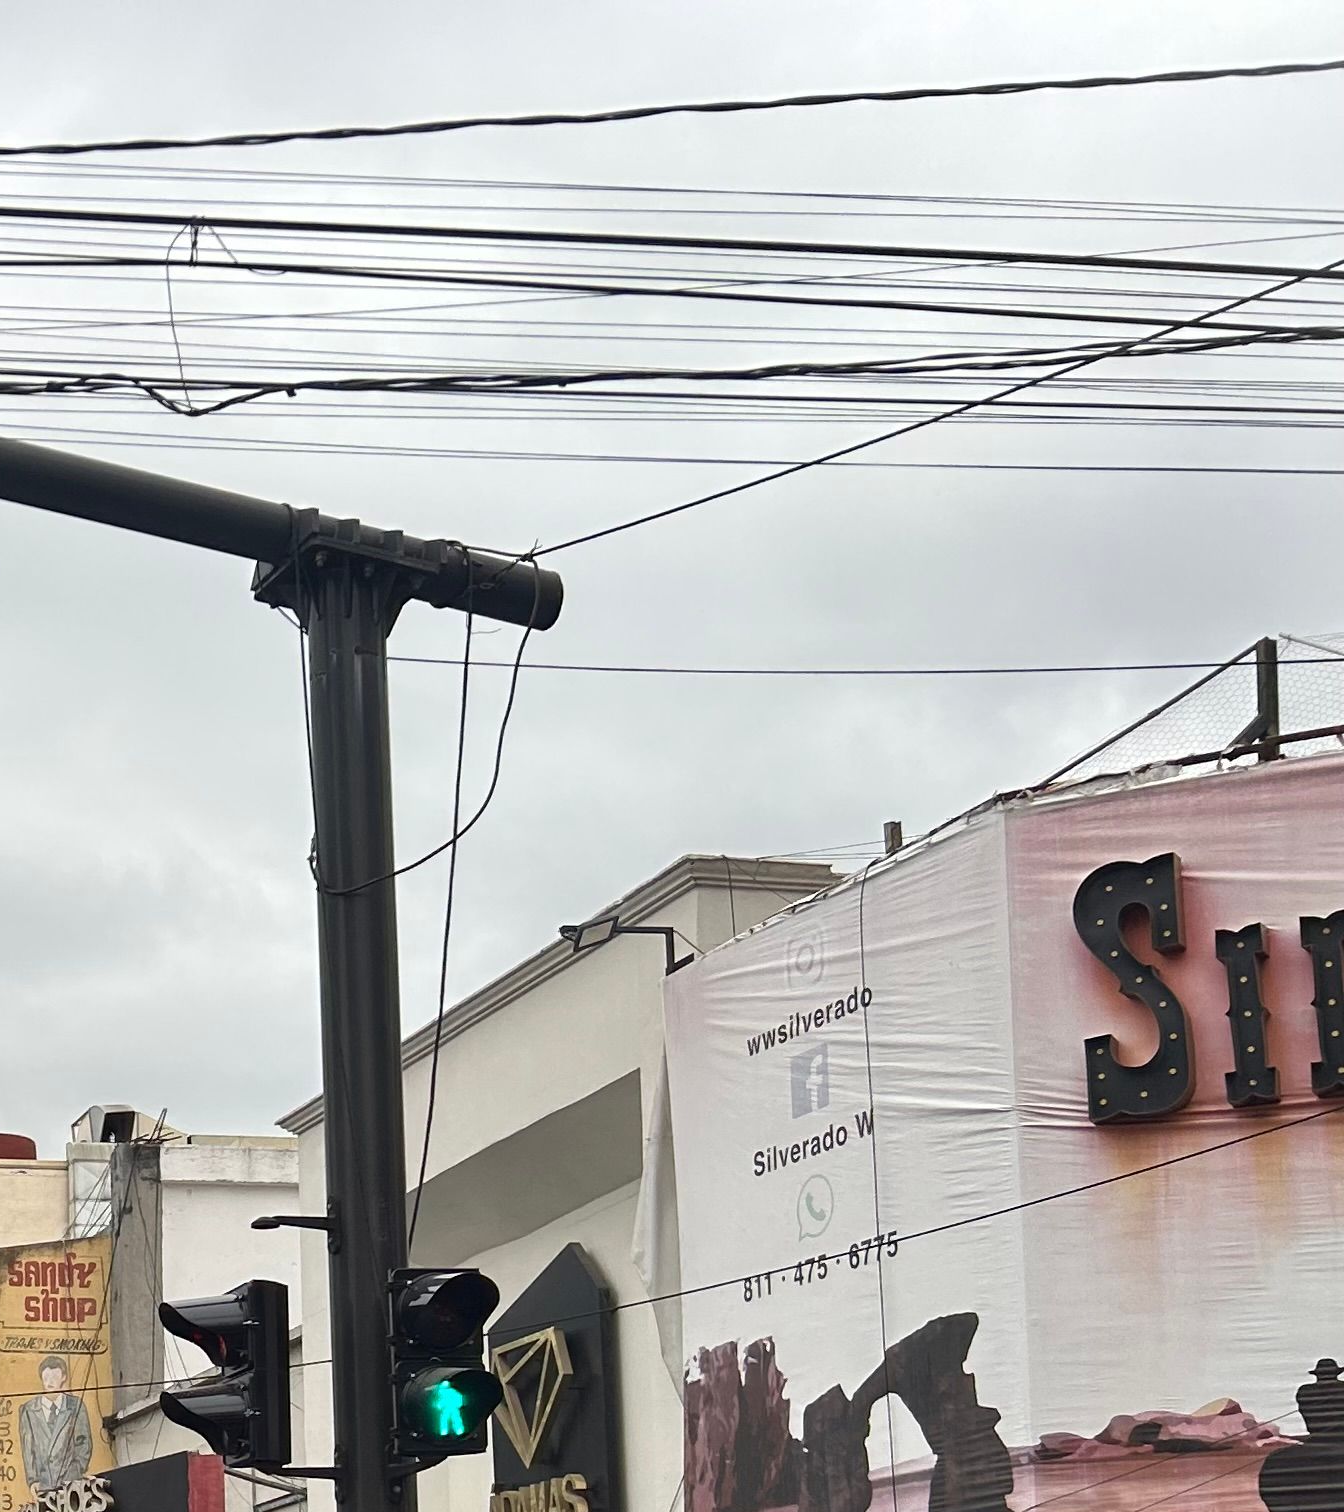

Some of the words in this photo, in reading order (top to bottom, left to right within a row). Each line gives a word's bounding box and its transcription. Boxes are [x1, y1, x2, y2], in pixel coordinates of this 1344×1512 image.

[746, 985, 873, 1057] wwsilverado
[753, 1123, 848, 1177] Silverado
[743, 1271, 773, 1302] 811
[793, 1254, 828, 1286] 475
[848, 1230, 899, 1270] 6775
